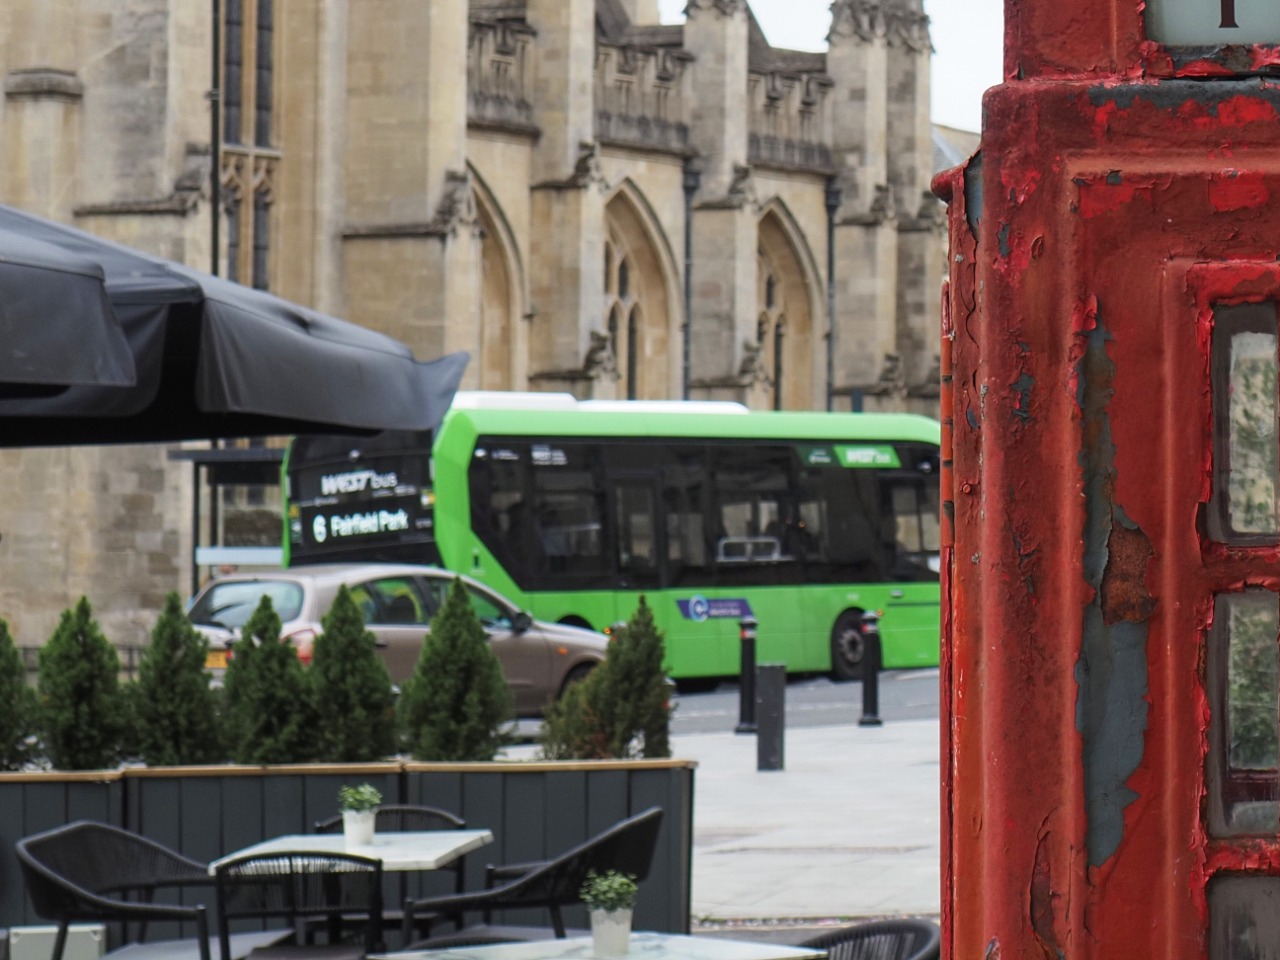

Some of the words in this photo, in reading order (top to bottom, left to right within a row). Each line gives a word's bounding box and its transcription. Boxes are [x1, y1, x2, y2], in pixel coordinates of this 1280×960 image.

[321, 470, 376, 495] WEST
[313, 514, 327, 543] 6
[330, 511, 379, 538] Fairfield
[379, 508, 409, 532] Park
